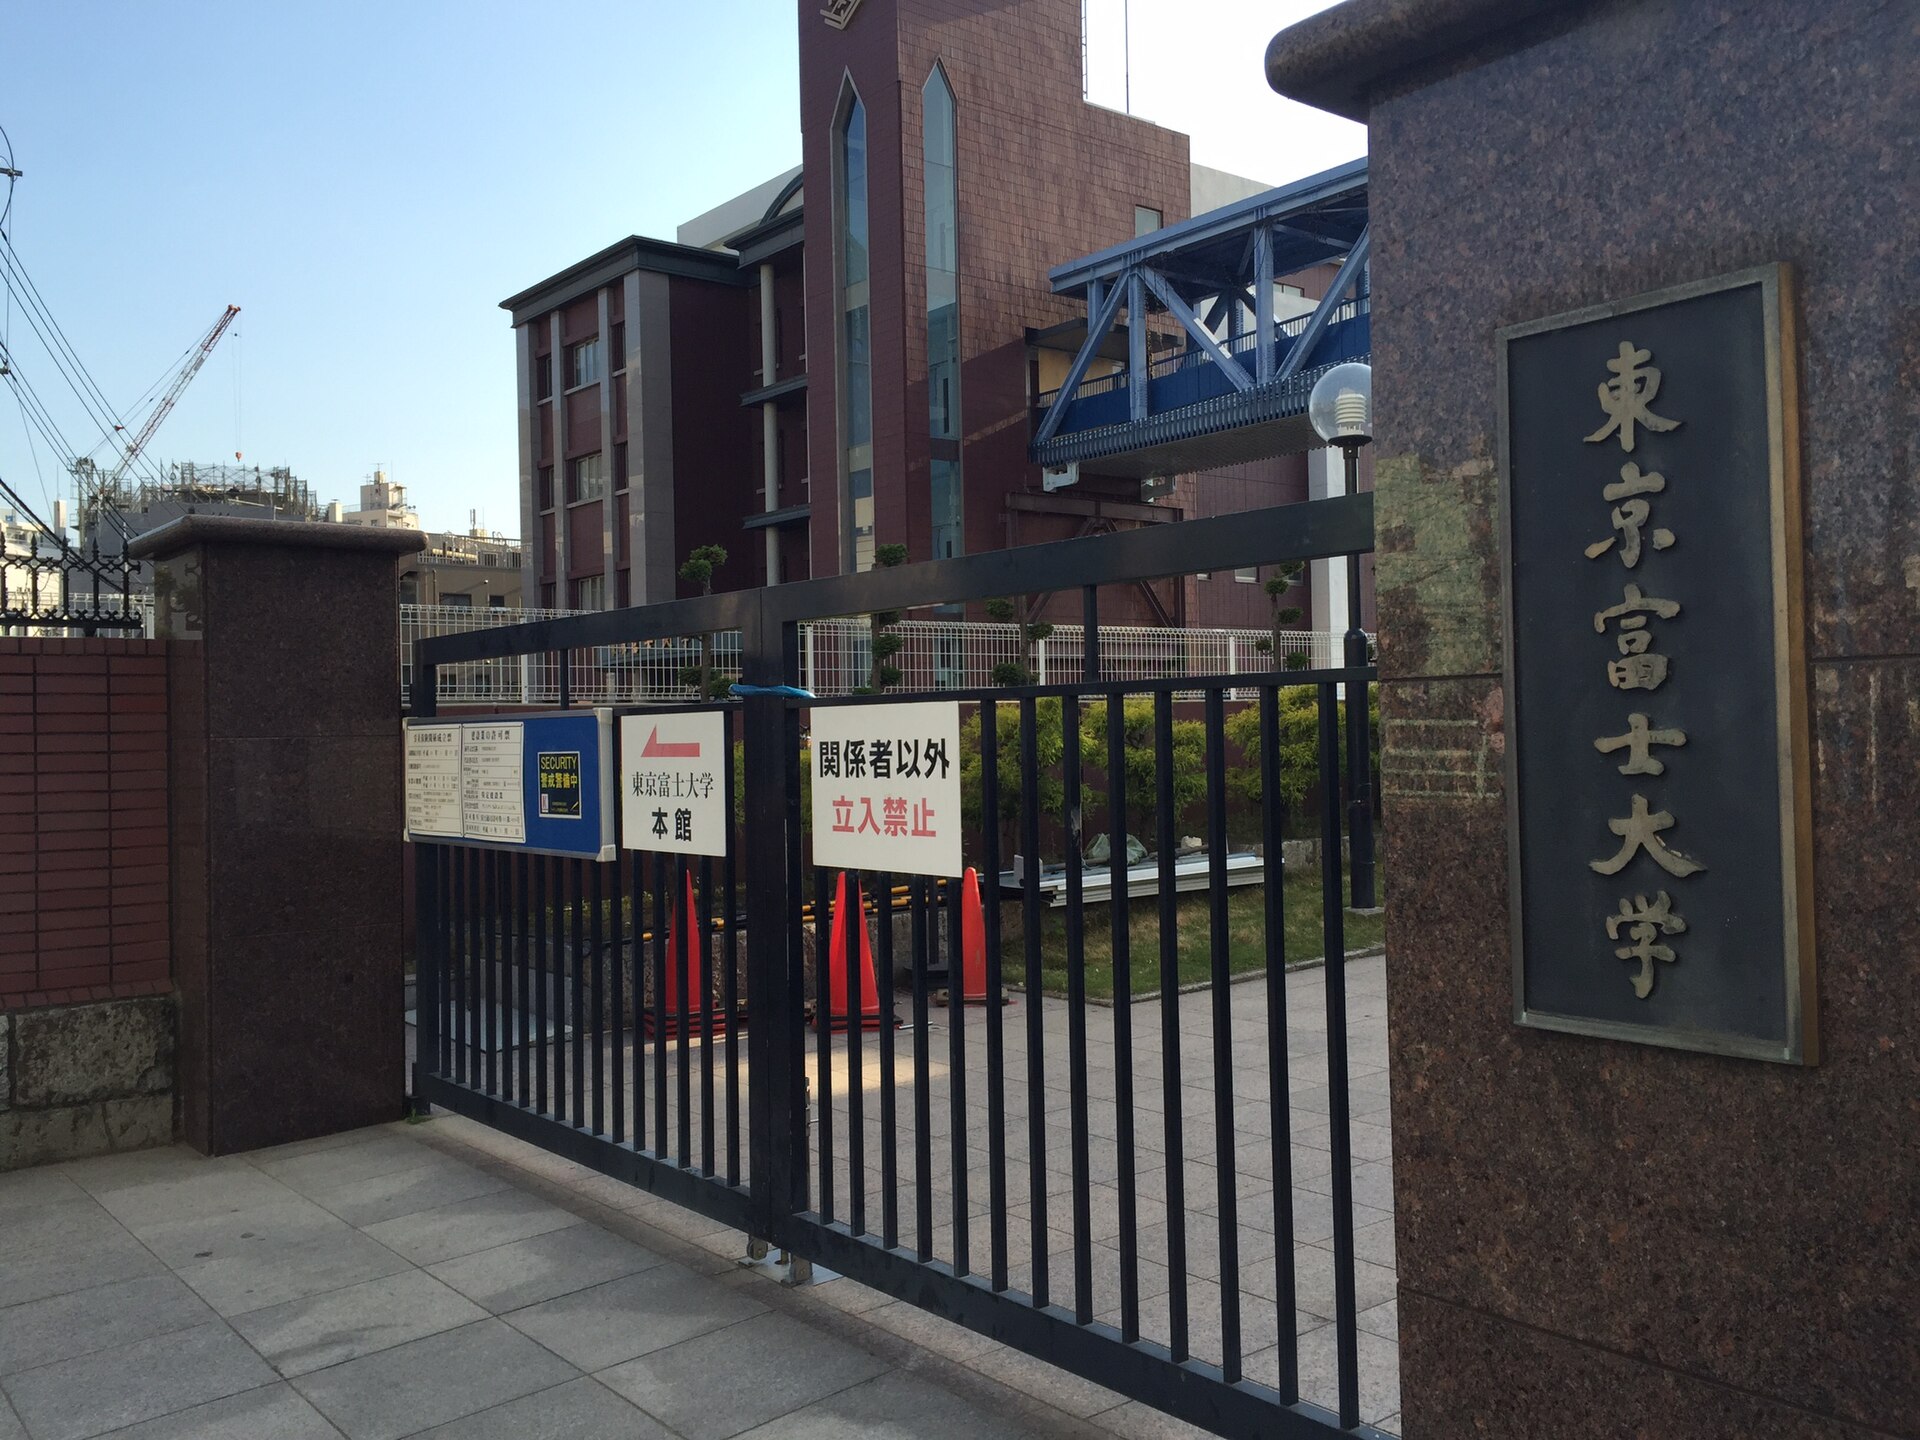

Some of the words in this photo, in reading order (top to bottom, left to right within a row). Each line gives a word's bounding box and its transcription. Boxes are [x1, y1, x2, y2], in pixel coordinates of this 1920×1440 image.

[1583, 340, 1707, 999] 東京富士大学
[540, 756, 577, 770] SECURITY
[819, 738, 950, 779] 関係者以外
[631, 771, 714, 799] 東京富士大学
[651, 807, 692, 842] 本館
[832, 795, 937, 838] 立入禁止
